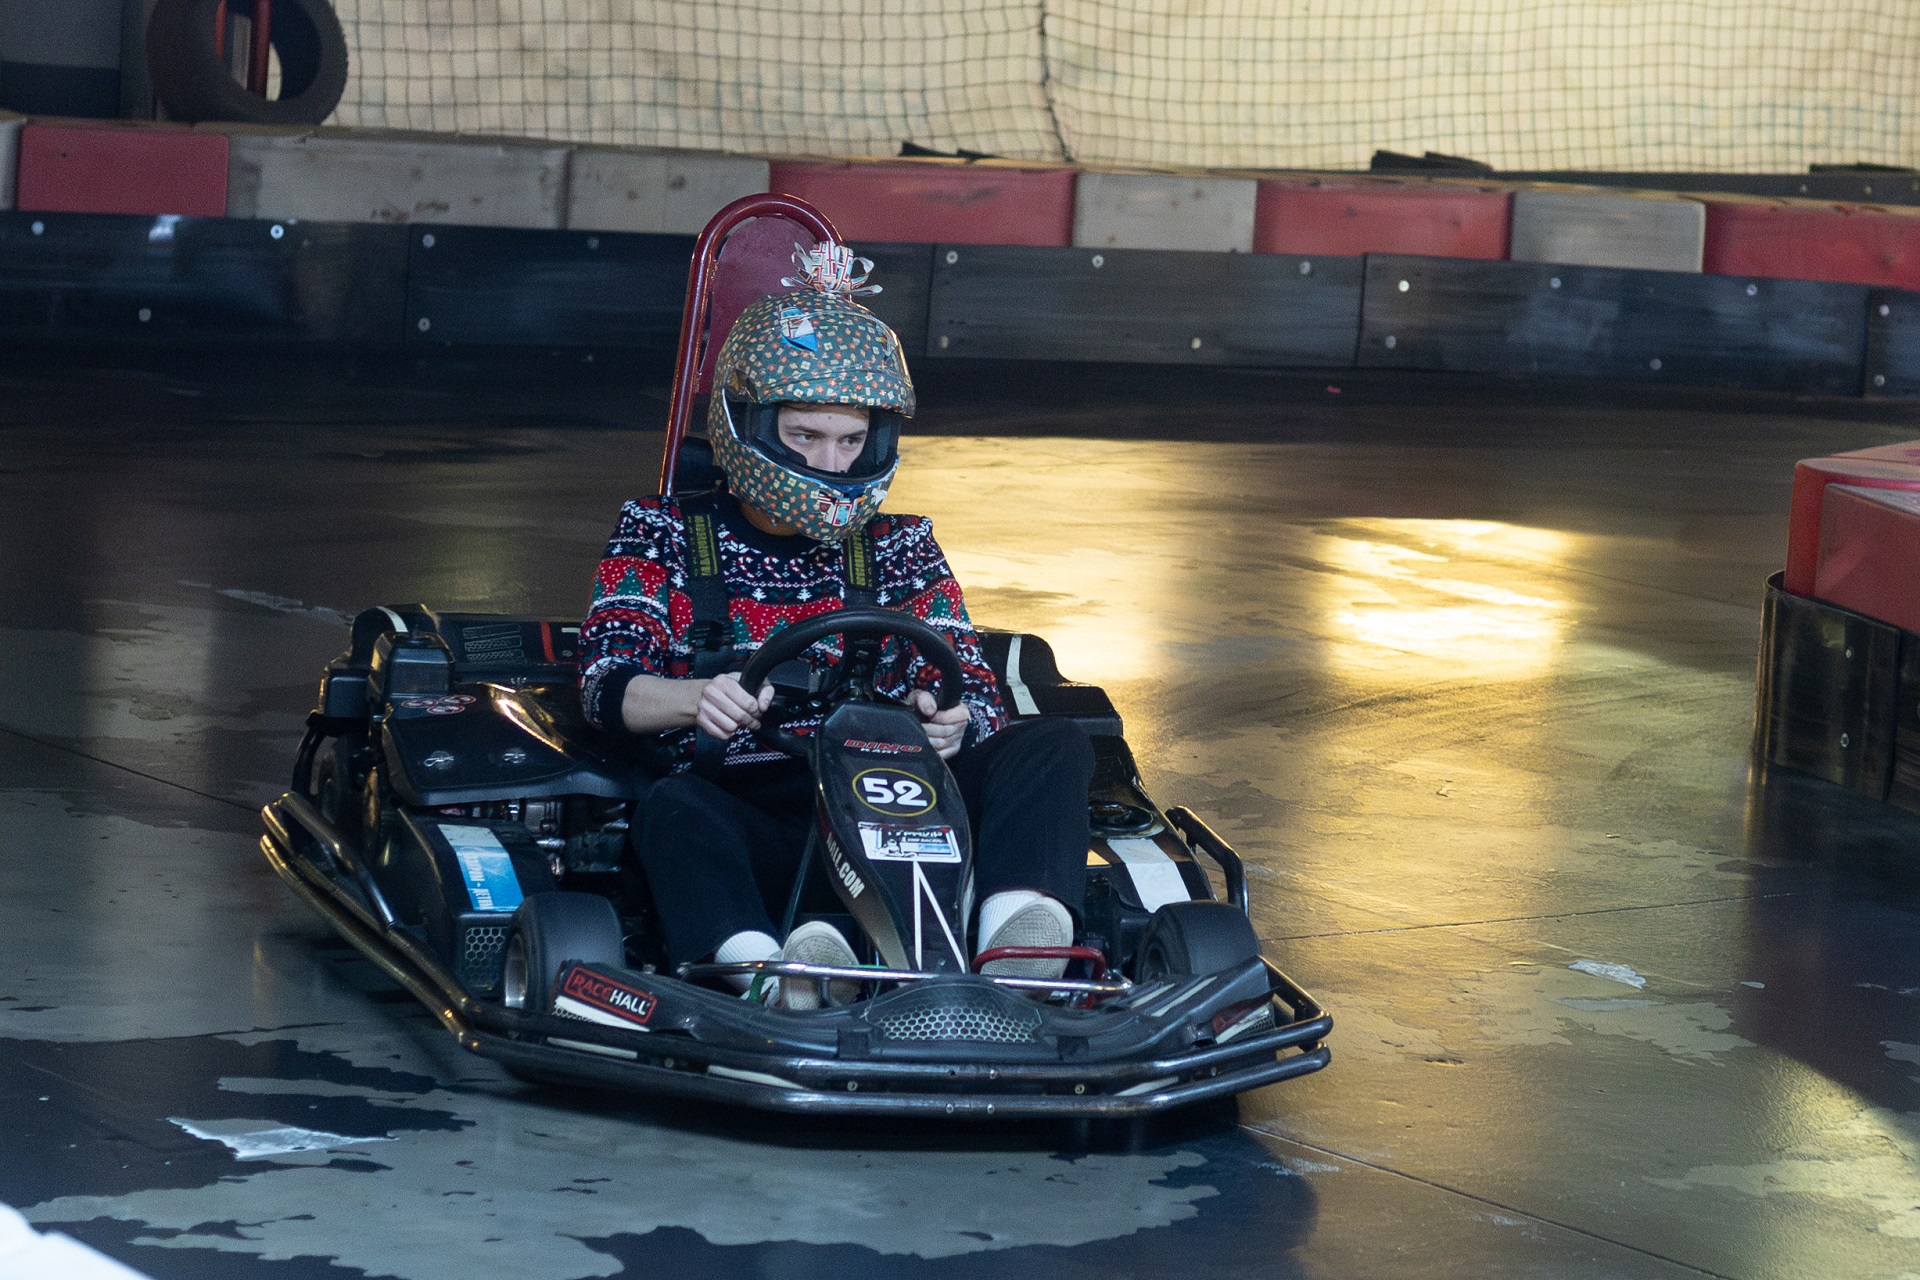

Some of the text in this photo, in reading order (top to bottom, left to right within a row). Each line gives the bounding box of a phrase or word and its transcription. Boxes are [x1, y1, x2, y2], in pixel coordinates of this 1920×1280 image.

[844, 739, 922, 753] DINO
[863, 777, 928, 807] 52
[571, 973, 647, 1016] RACEHALL
